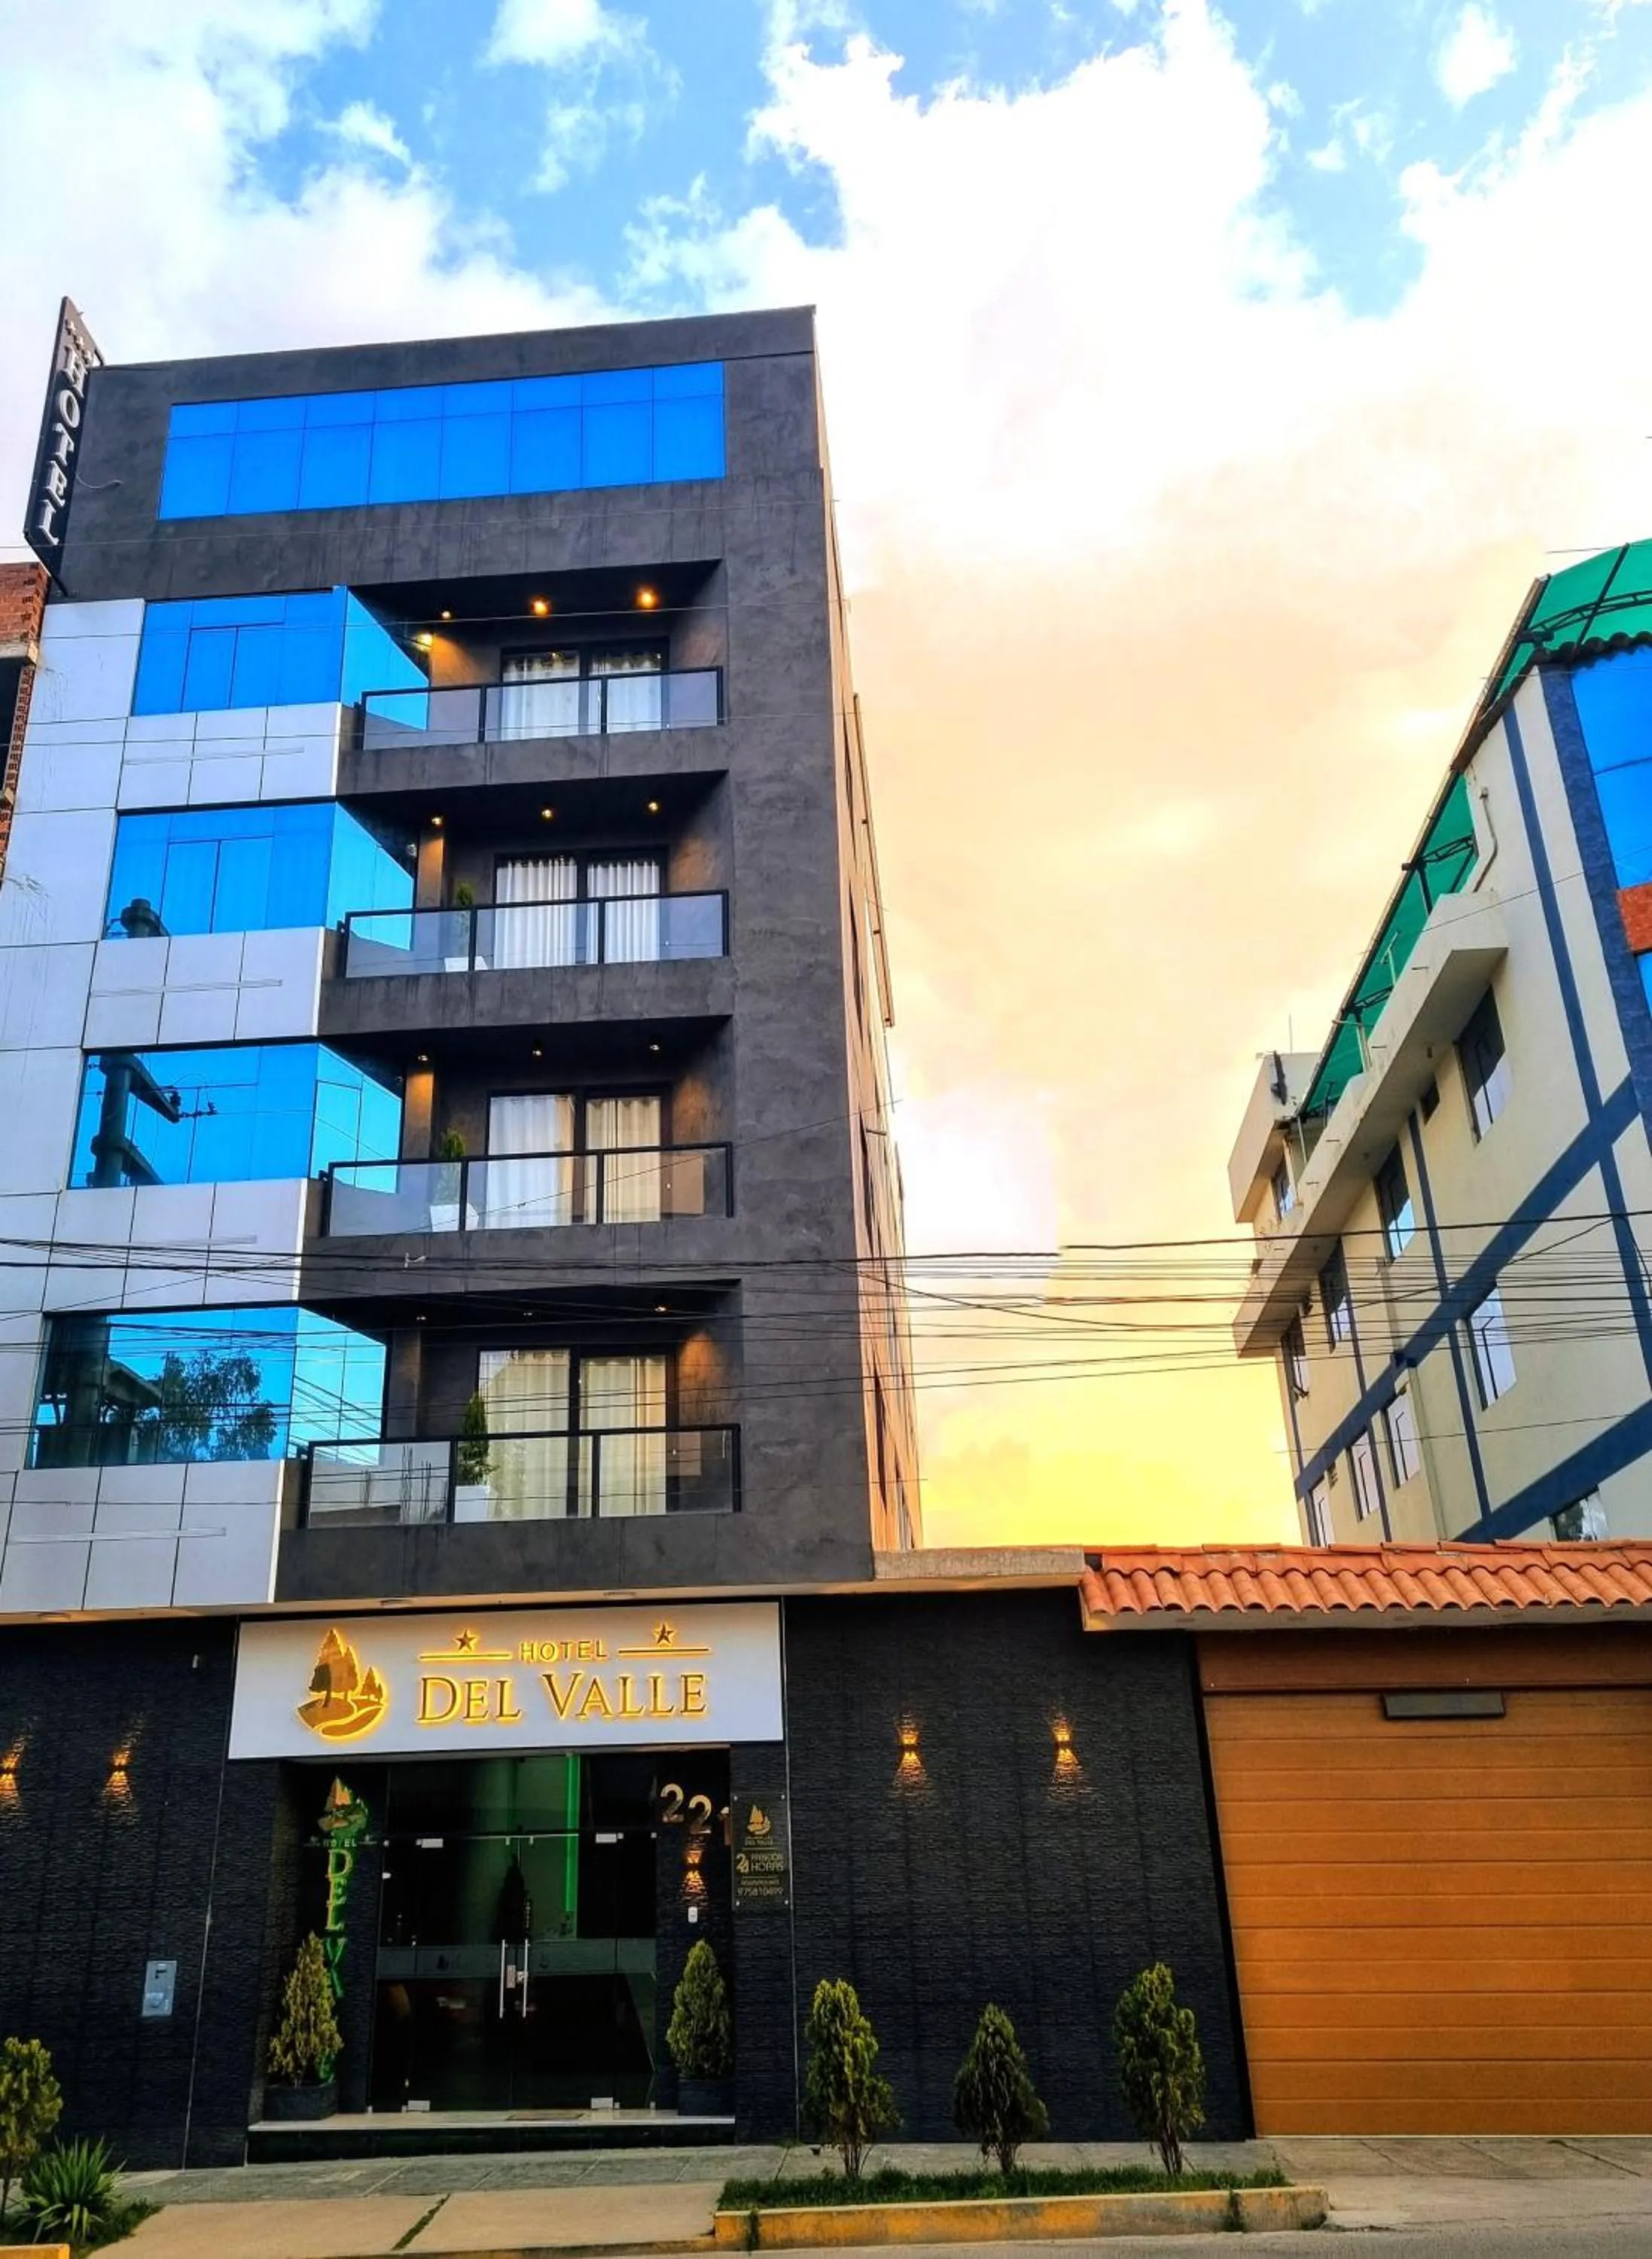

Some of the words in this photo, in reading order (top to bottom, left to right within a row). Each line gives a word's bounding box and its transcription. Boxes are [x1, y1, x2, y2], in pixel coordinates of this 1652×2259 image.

[38, 345, 85, 547] HOTEL
[520, 1639, 608, 1662] HOTEL
[418, 1675, 522, 1722] DEL
[542, 1672, 708, 1719] VALLE
[660, 1783, 733, 1846] 221
[325, 1849, 353, 1931] DEL
